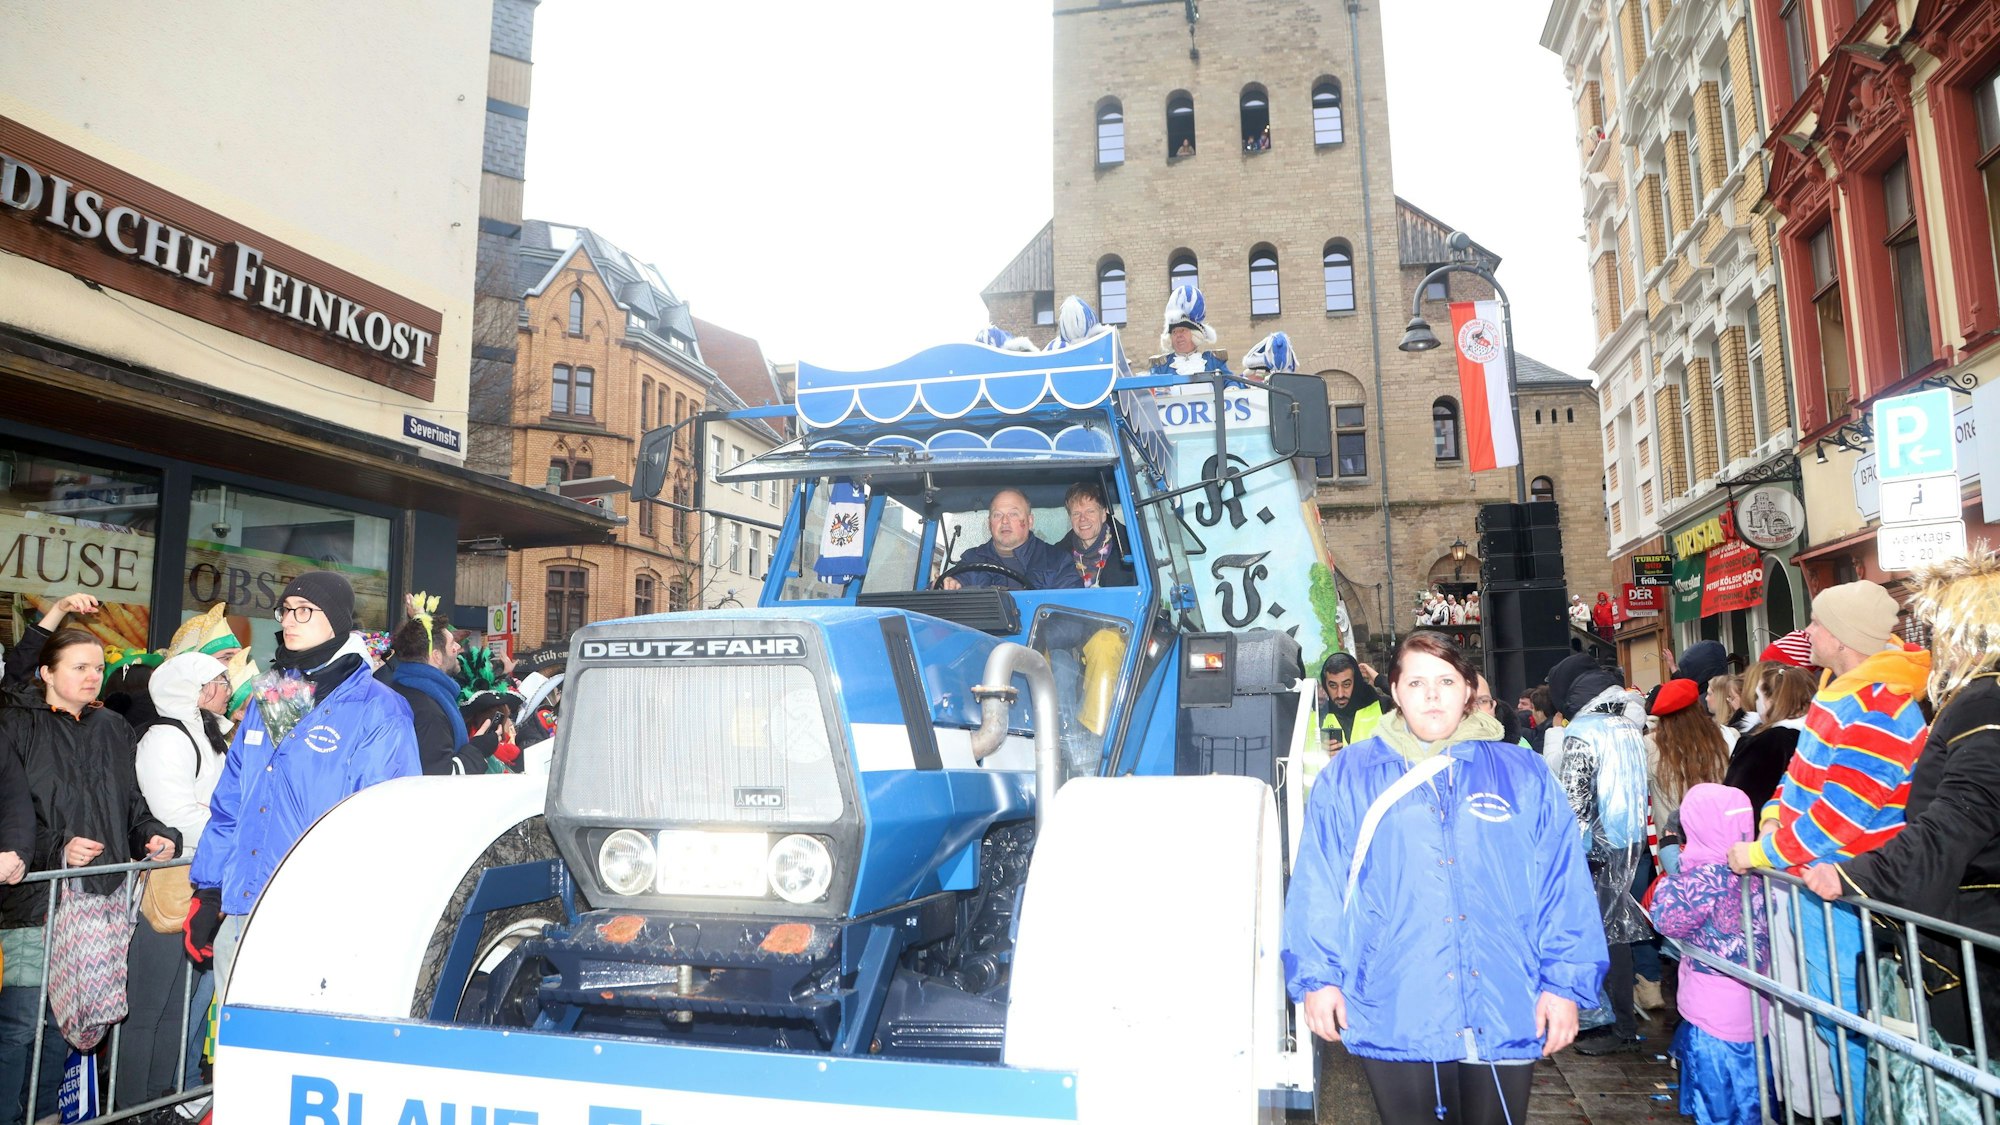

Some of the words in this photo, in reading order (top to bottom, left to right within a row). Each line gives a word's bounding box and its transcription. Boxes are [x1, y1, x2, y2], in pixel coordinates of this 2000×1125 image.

[228, 241, 432, 367] FEINKOST
[410, 418, 457, 447] Severinstr.
[1886, 406, 1928, 469] P
[1674, 517, 1726, 560] TURISTA
[1634, 555, 1671, 563] TURISTA
[1720, 575, 1742, 586] KÖLSCH
[1629, 589, 1653, 600] DER
[584, 639, 799, 657] DEUTZ-FAHR
[533, 650, 557, 664] früh
[744, 794, 781, 806] KHD
